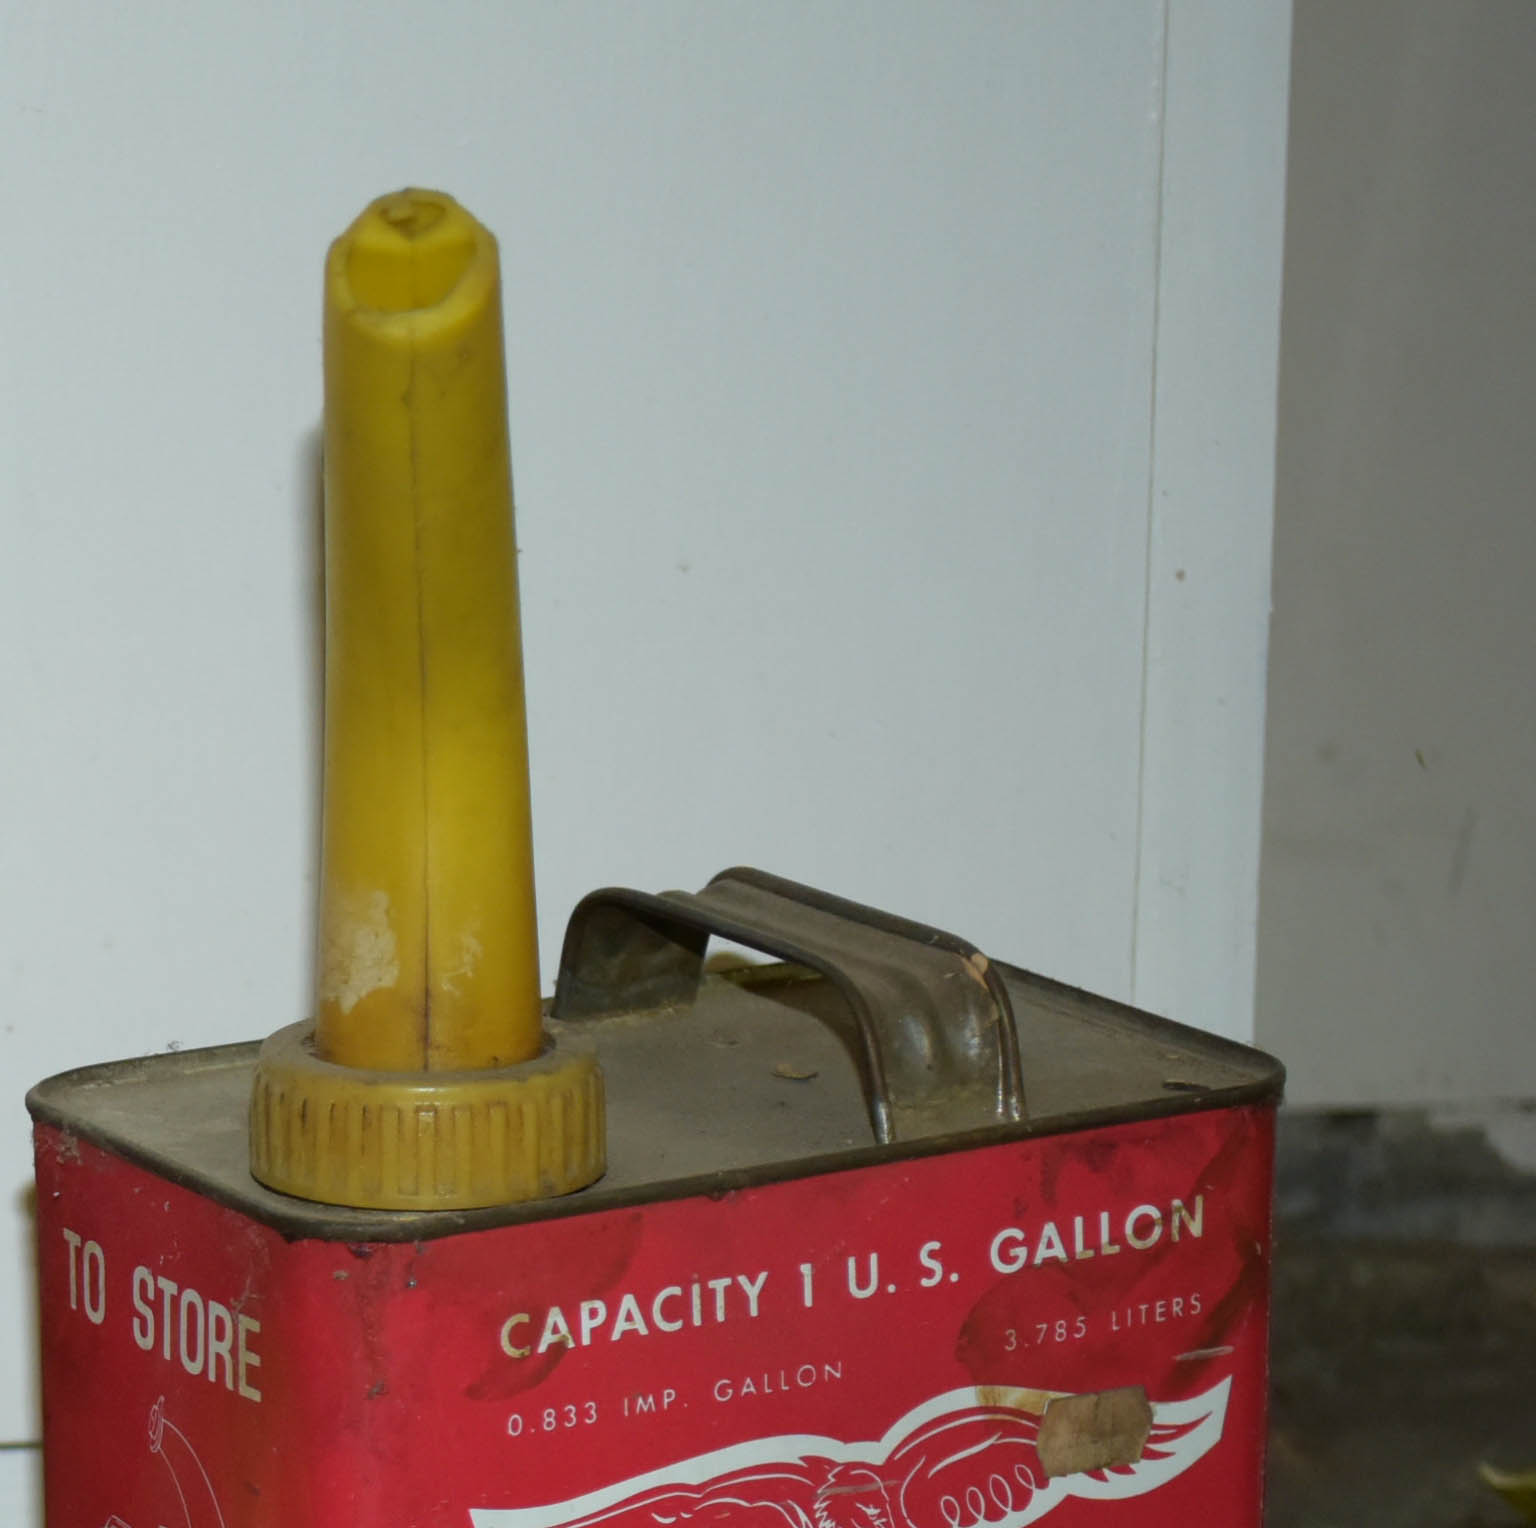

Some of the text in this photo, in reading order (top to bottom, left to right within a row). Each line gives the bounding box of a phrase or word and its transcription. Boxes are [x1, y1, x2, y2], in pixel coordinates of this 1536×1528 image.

[63, 1227, 262, 1402] TO STORE
[498, 1271, 769, 1360] CAPACITY
[800, 1262, 815, 1309] 1
[989, 1194, 1206, 1275] GALLON
[1004, 1293, 1204, 1352] 3.785 LITERS
[506, 1361, 845, 1437] 0.833 IMP. GALLON
